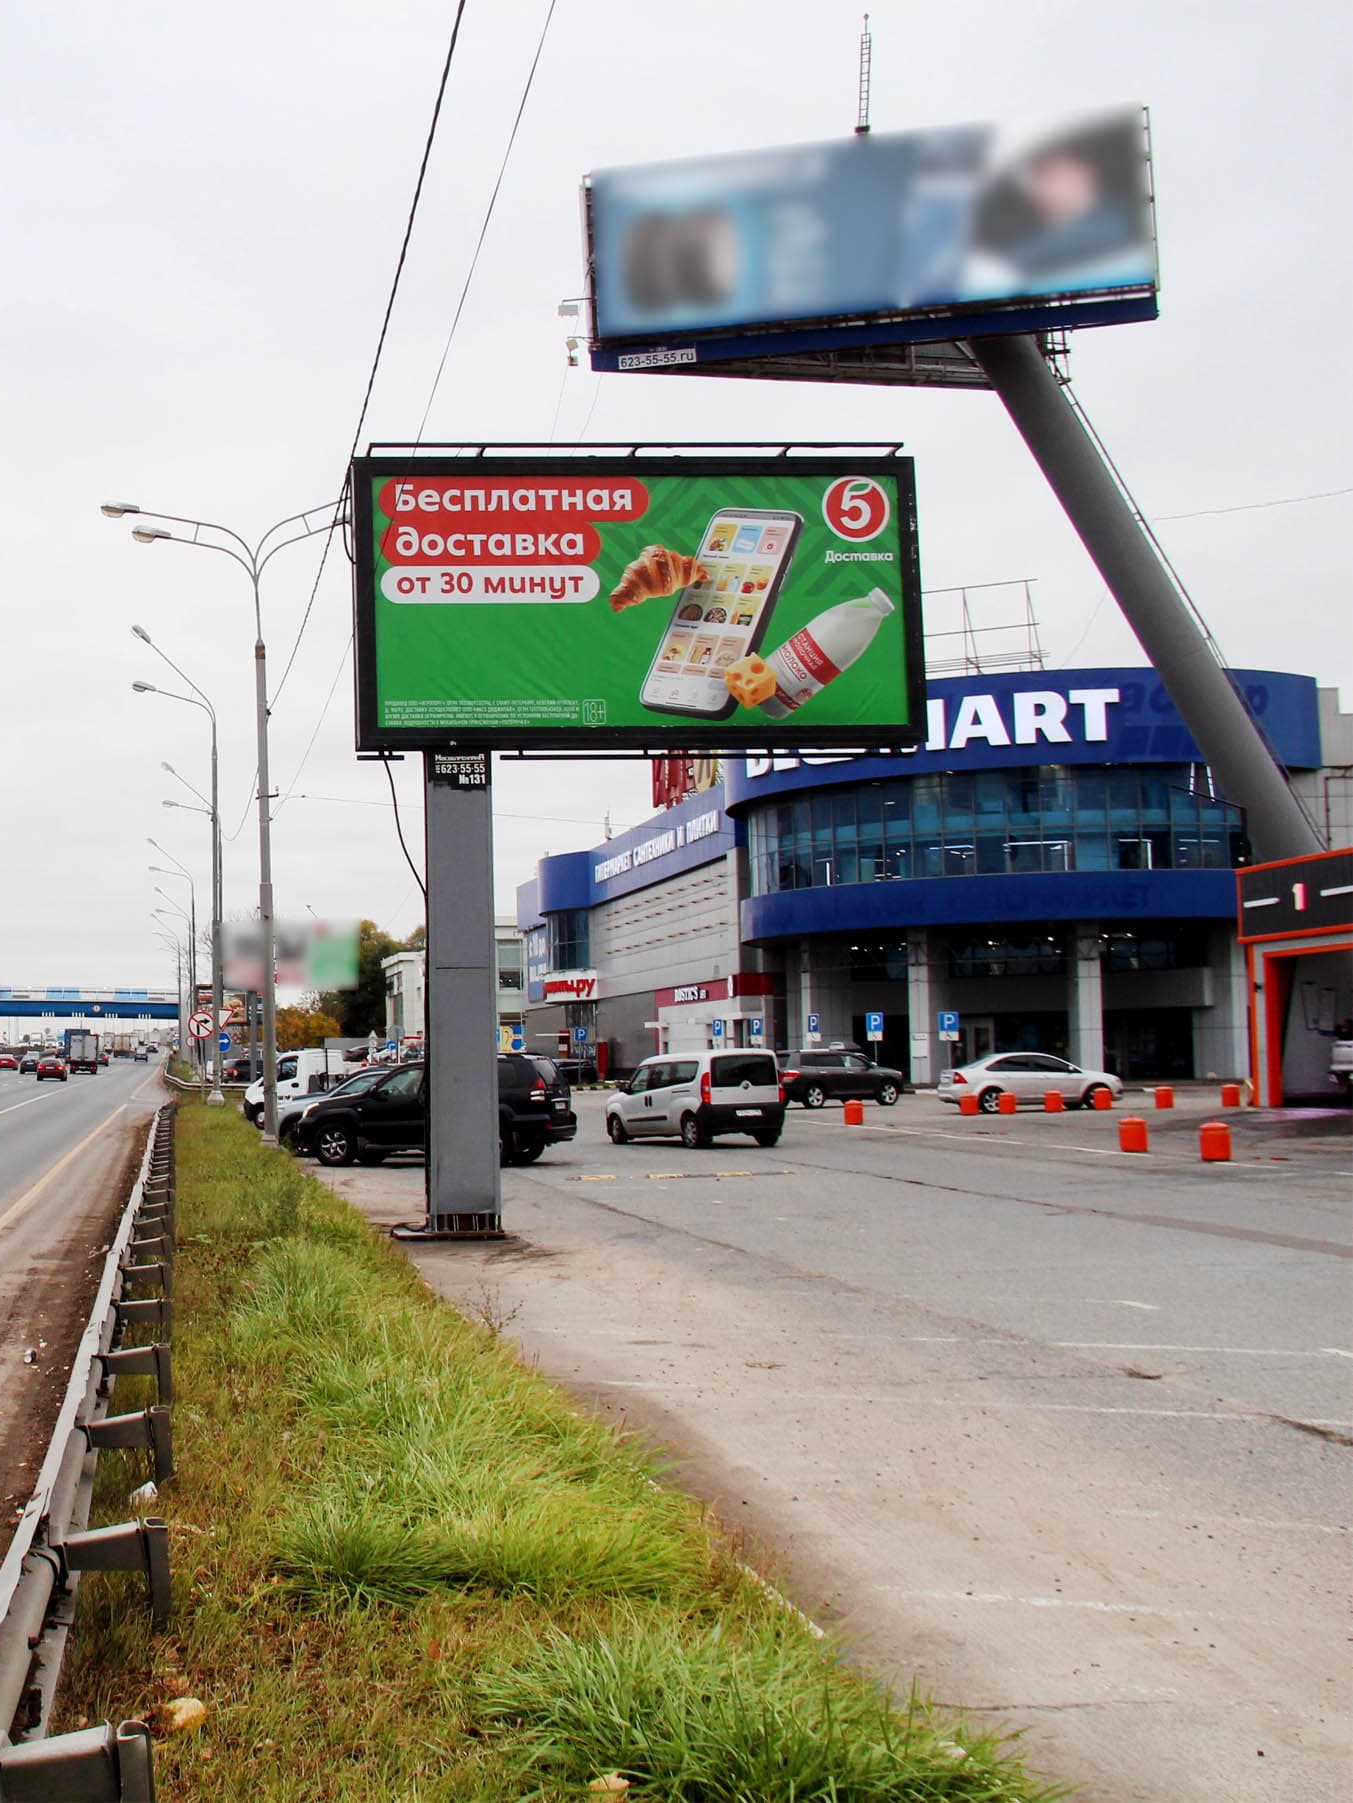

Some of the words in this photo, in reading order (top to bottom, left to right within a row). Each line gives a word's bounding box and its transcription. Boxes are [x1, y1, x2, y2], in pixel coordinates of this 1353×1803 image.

[620, 351, 695, 368] 623-55-55.ru
[395, 484, 633, 512] Бесплатная
[840, 481, 873, 529] 5
[395, 526, 585, 557] доставка
[824, 550, 894, 564] Доставка
[397, 576, 431, 595] от
[440, 572, 474, 594] 30
[484, 575, 584, 600] минут
[584, 702, 604, 722] 18+
[440, 763, 486, 774] 623-55-55
[1292, 882, 1307, 912] 1
